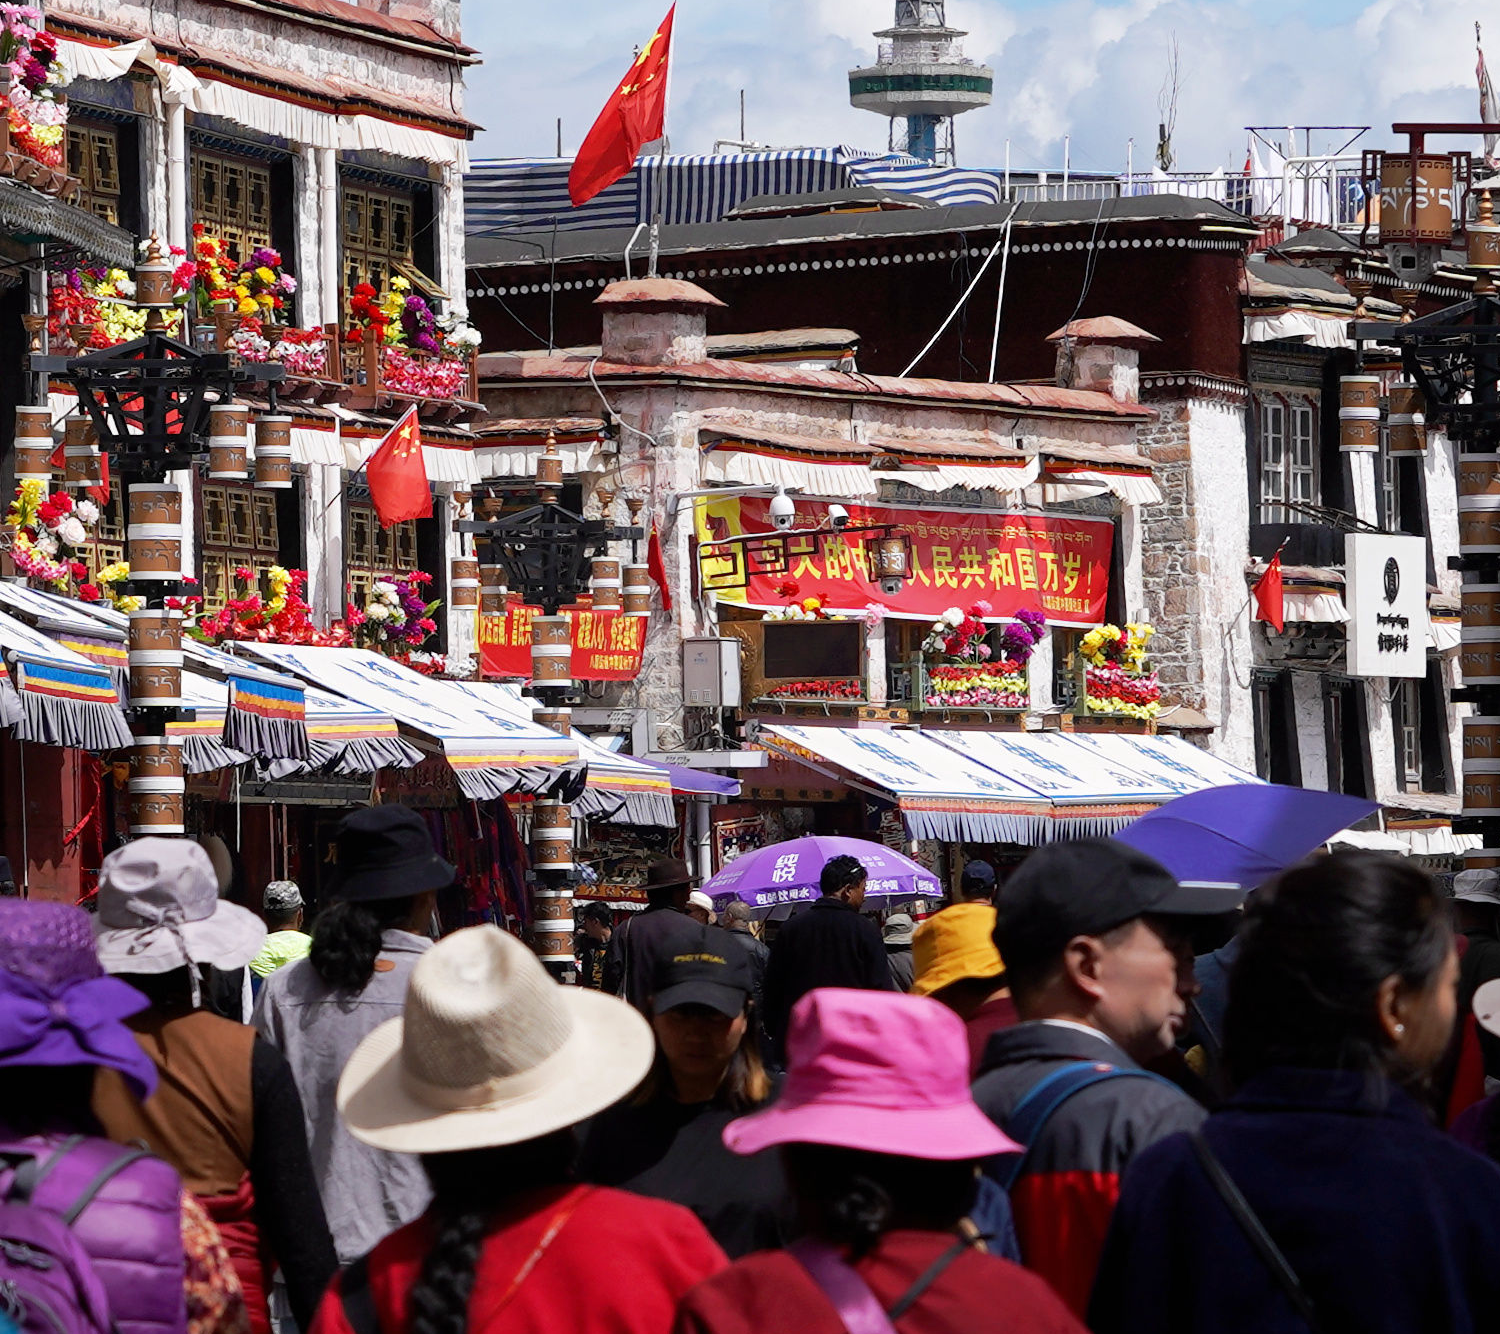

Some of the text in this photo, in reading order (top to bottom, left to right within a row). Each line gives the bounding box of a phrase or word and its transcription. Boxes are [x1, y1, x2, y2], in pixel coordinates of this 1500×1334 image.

[762, 535, 1092, 596] 伟大的中人民共和国万岁！
[771, 853, 800, 884] 纯悦
